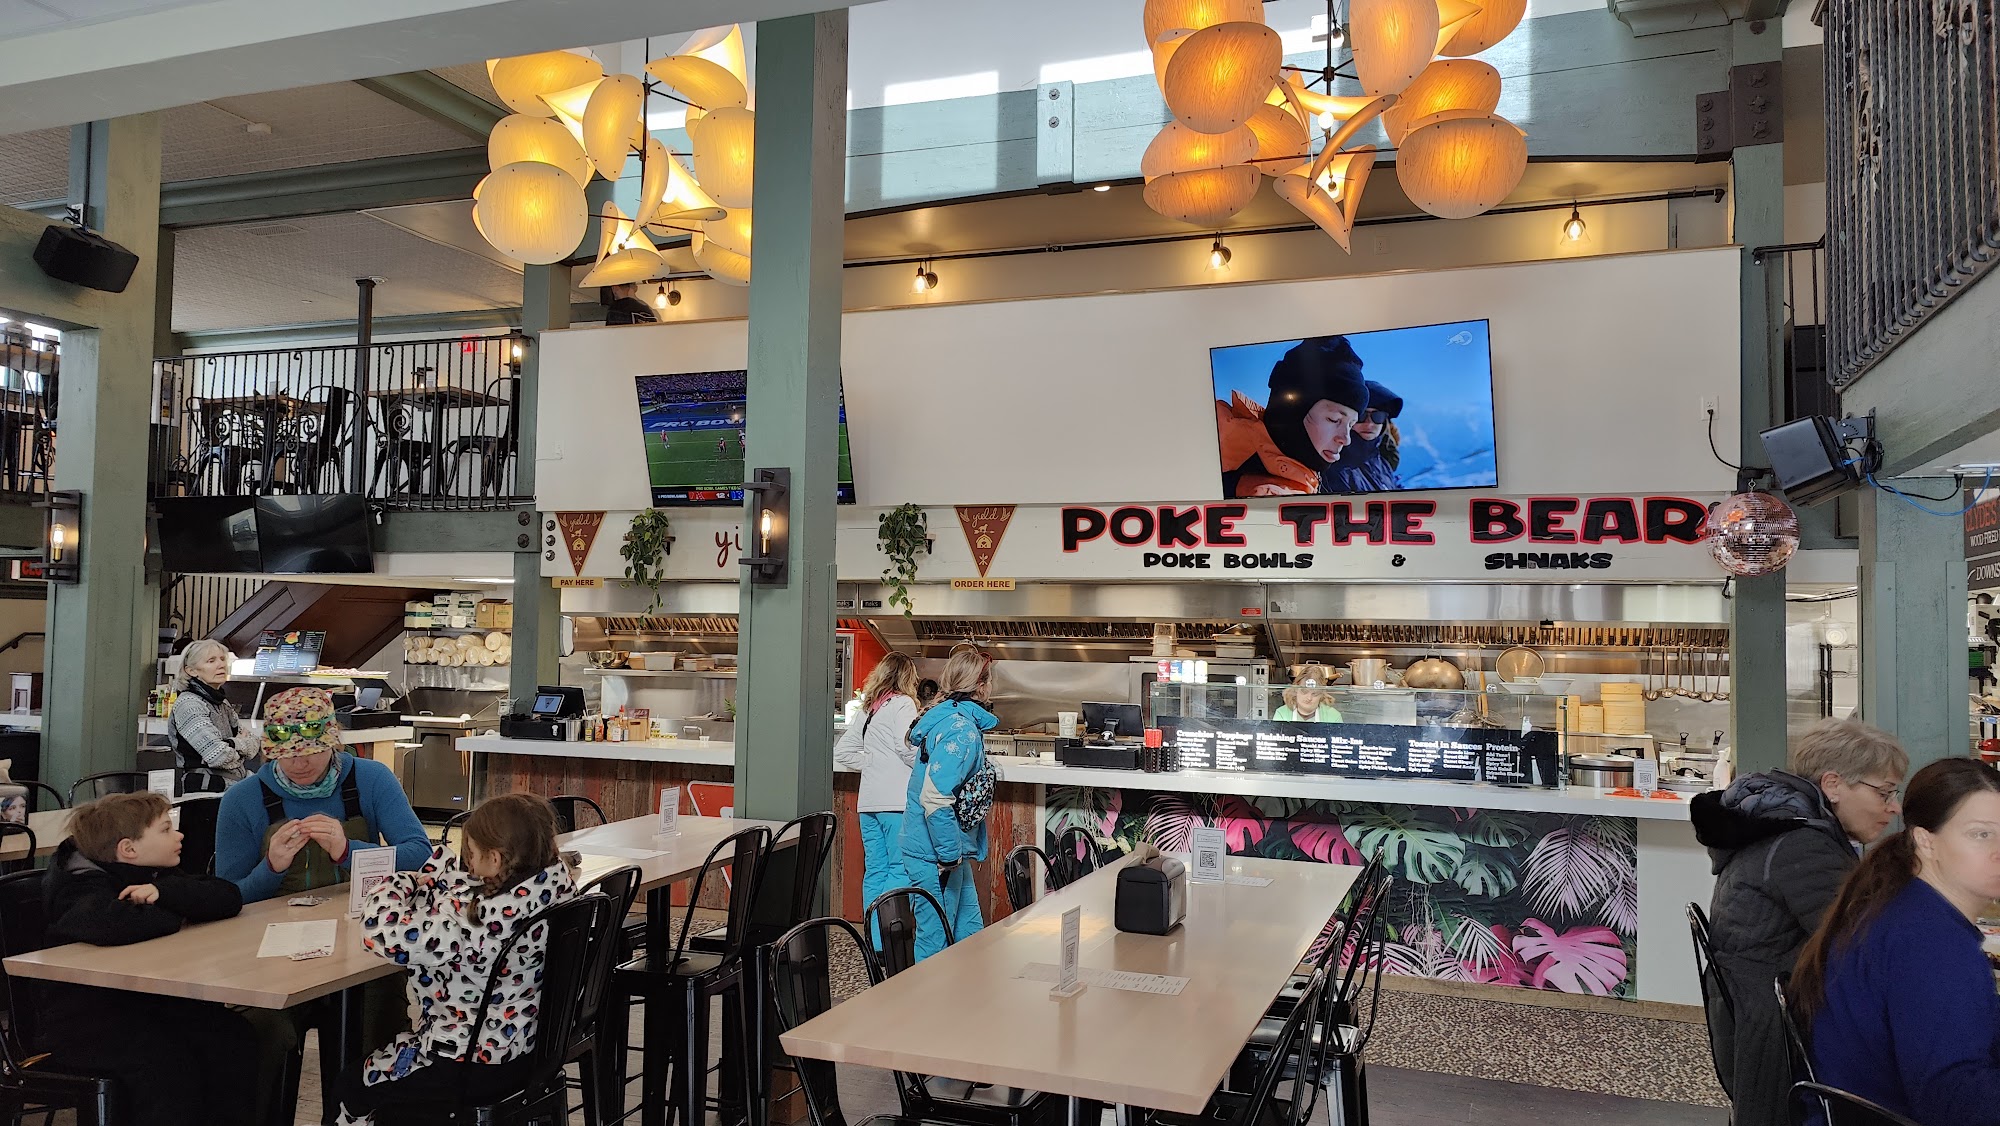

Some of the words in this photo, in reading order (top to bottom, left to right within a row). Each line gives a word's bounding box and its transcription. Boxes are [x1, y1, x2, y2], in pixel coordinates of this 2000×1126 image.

[649, 420, 694, 428] PRO
[696, 418, 745, 426] BOW
[1062, 503, 1247, 553] POKE
[1279, 500, 1437, 548] THE
[1470, 496, 1708, 545] BEAR
[1143, 553, 1211, 569] POKE
[1223, 553, 1315, 569] BOWLS
[1391, 553, 1406, 568] &
[1484, 552, 1613, 570] SHNAKS
[1975, 562, 2000, 581] DOWNS
[954, 580, 985, 588] ORDER
[986, 580, 1011, 588] HERE
[1256, 732, 1296, 744] Finishing
[1296, 734, 1326, 743] Sauces
[1331, 736, 1364, 745] Mix-Ins
[1408, 740, 1440, 748] Tossed
[1440, 740, 1450, 748] in
[1450, 742, 1482, 750] Sauces
[1486, 742, 1518, 752] Protein
